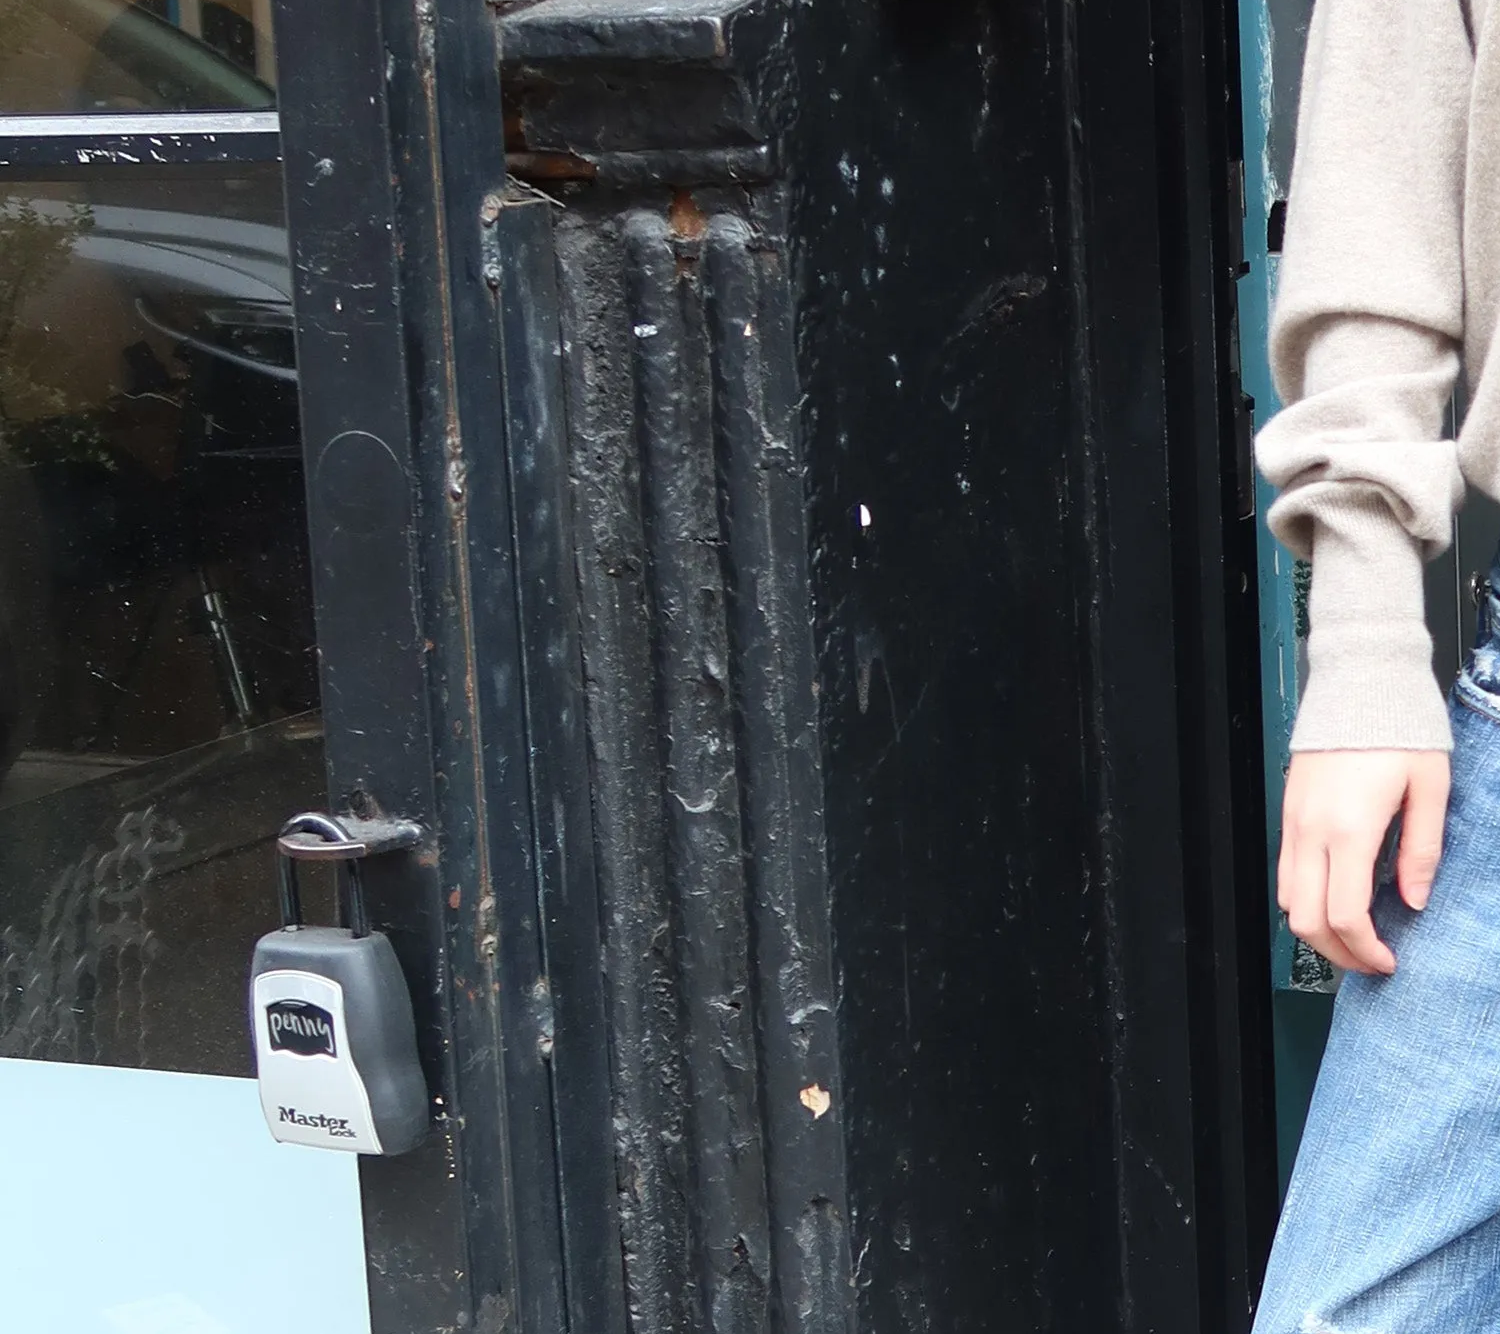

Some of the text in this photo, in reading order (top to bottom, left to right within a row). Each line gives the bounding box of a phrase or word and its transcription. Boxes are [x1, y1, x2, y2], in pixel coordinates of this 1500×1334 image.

[270, 1012, 334, 1055] penny
[278, 1105, 349, 1130] Master
[329, 1126, 357, 1139] Lock
